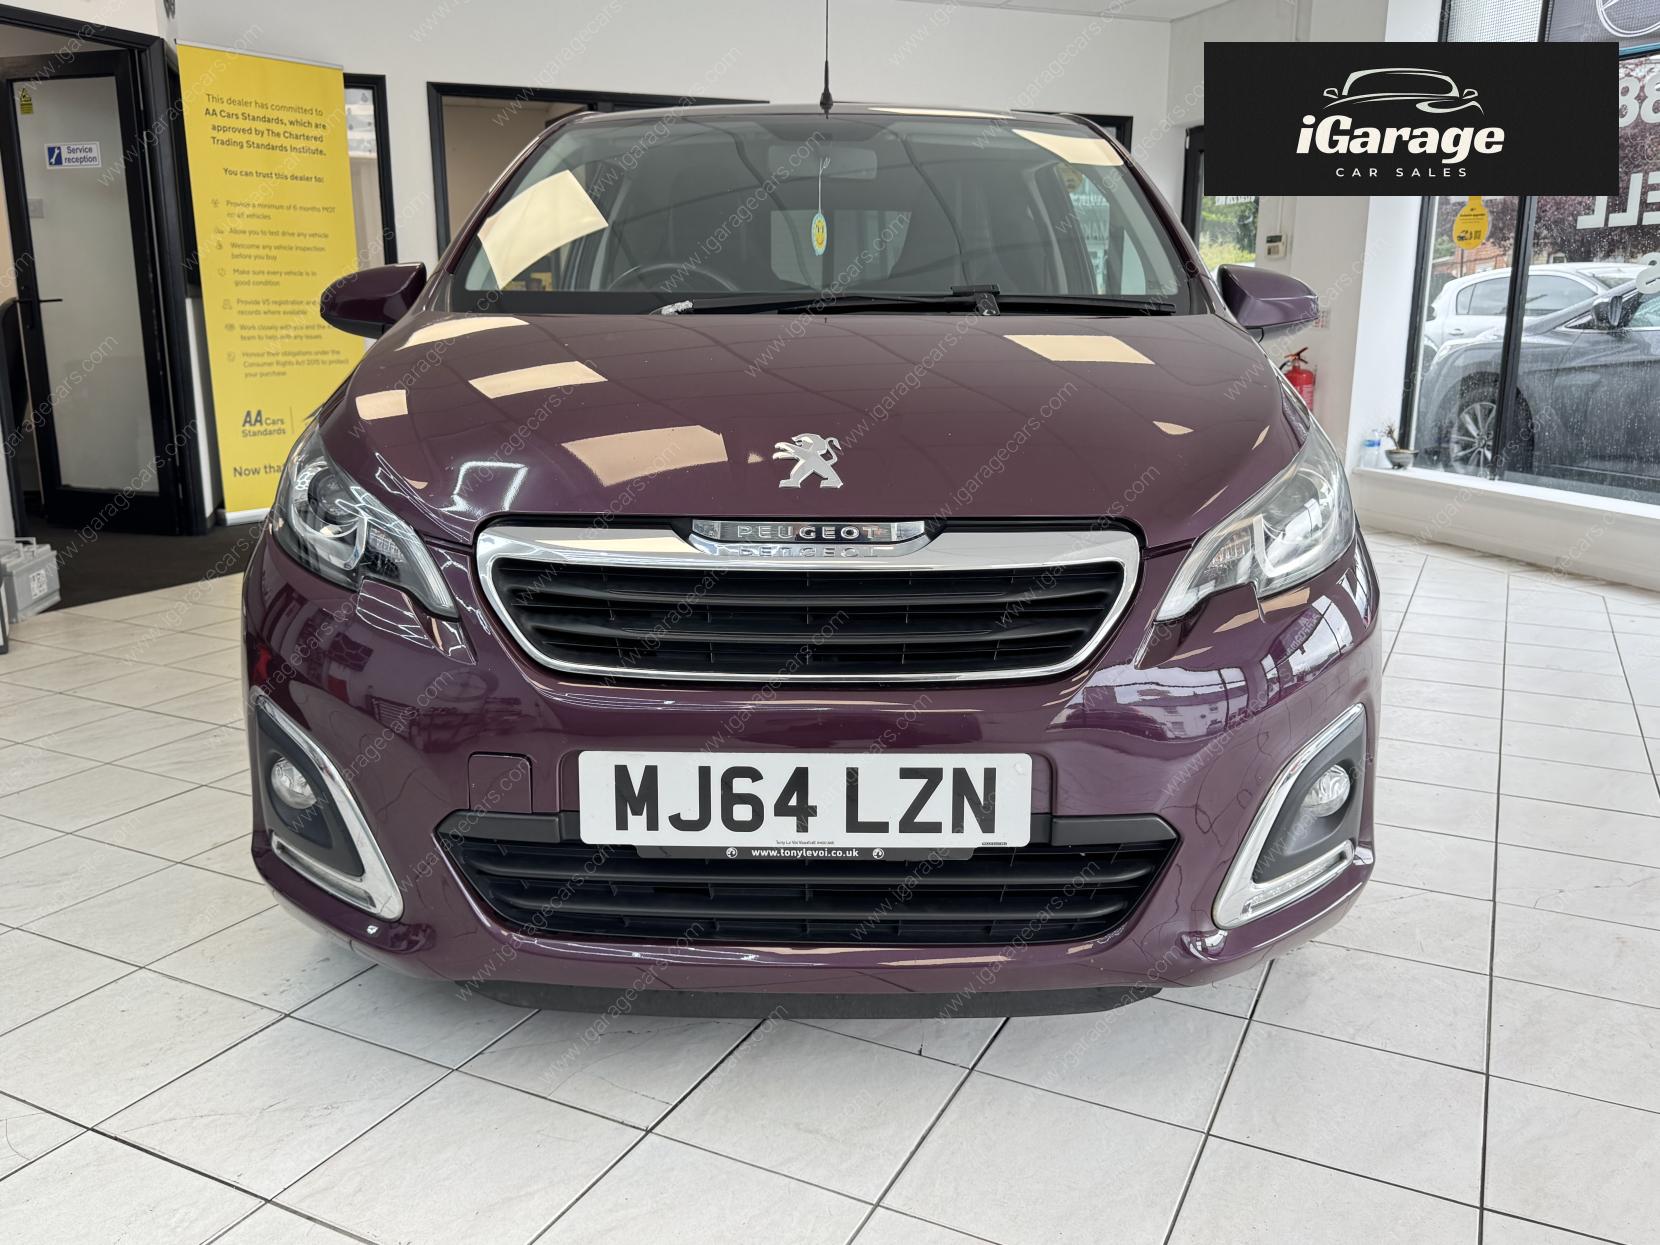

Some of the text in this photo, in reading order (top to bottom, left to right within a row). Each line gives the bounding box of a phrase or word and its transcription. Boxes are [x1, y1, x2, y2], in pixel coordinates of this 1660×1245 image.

[206, 93, 323, 116] This dealer has committed to
[205, 108, 217, 117] AA
[220, 110, 239, 119] Cars
[242, 112, 287, 126] Standards,
[289, 118, 312, 128] which
[212, 123, 323, 142] approved by The Chartered
[67, 146, 92, 154] Service
[211, 136, 326, 156] Trading Standards Institute.
[65, 155, 97, 164] reception
[224, 168, 237, 176] You
[256, 170, 273, 179] trust
[290, 174, 312, 182] dealer
[246, 212, 271, 220] vehicles
[281, 229, 295, 237] drive
[230, 242, 260, 250] Welcome
[274, 244, 293, 252] vehicle
[233, 268, 250, 276] Make
[284, 269, 303, 277] vehicle
[242, 410, 285, 427] AA Cars
[242, 428, 286, 437] Standards
[233, 464, 282, 477] Now tha
[737, 525, 880, 539] PEUGEOT
[614, 764, 996, 834] MJ64 LZN
[752, 848, 858, 858] www.tonylevoi.co.uk
